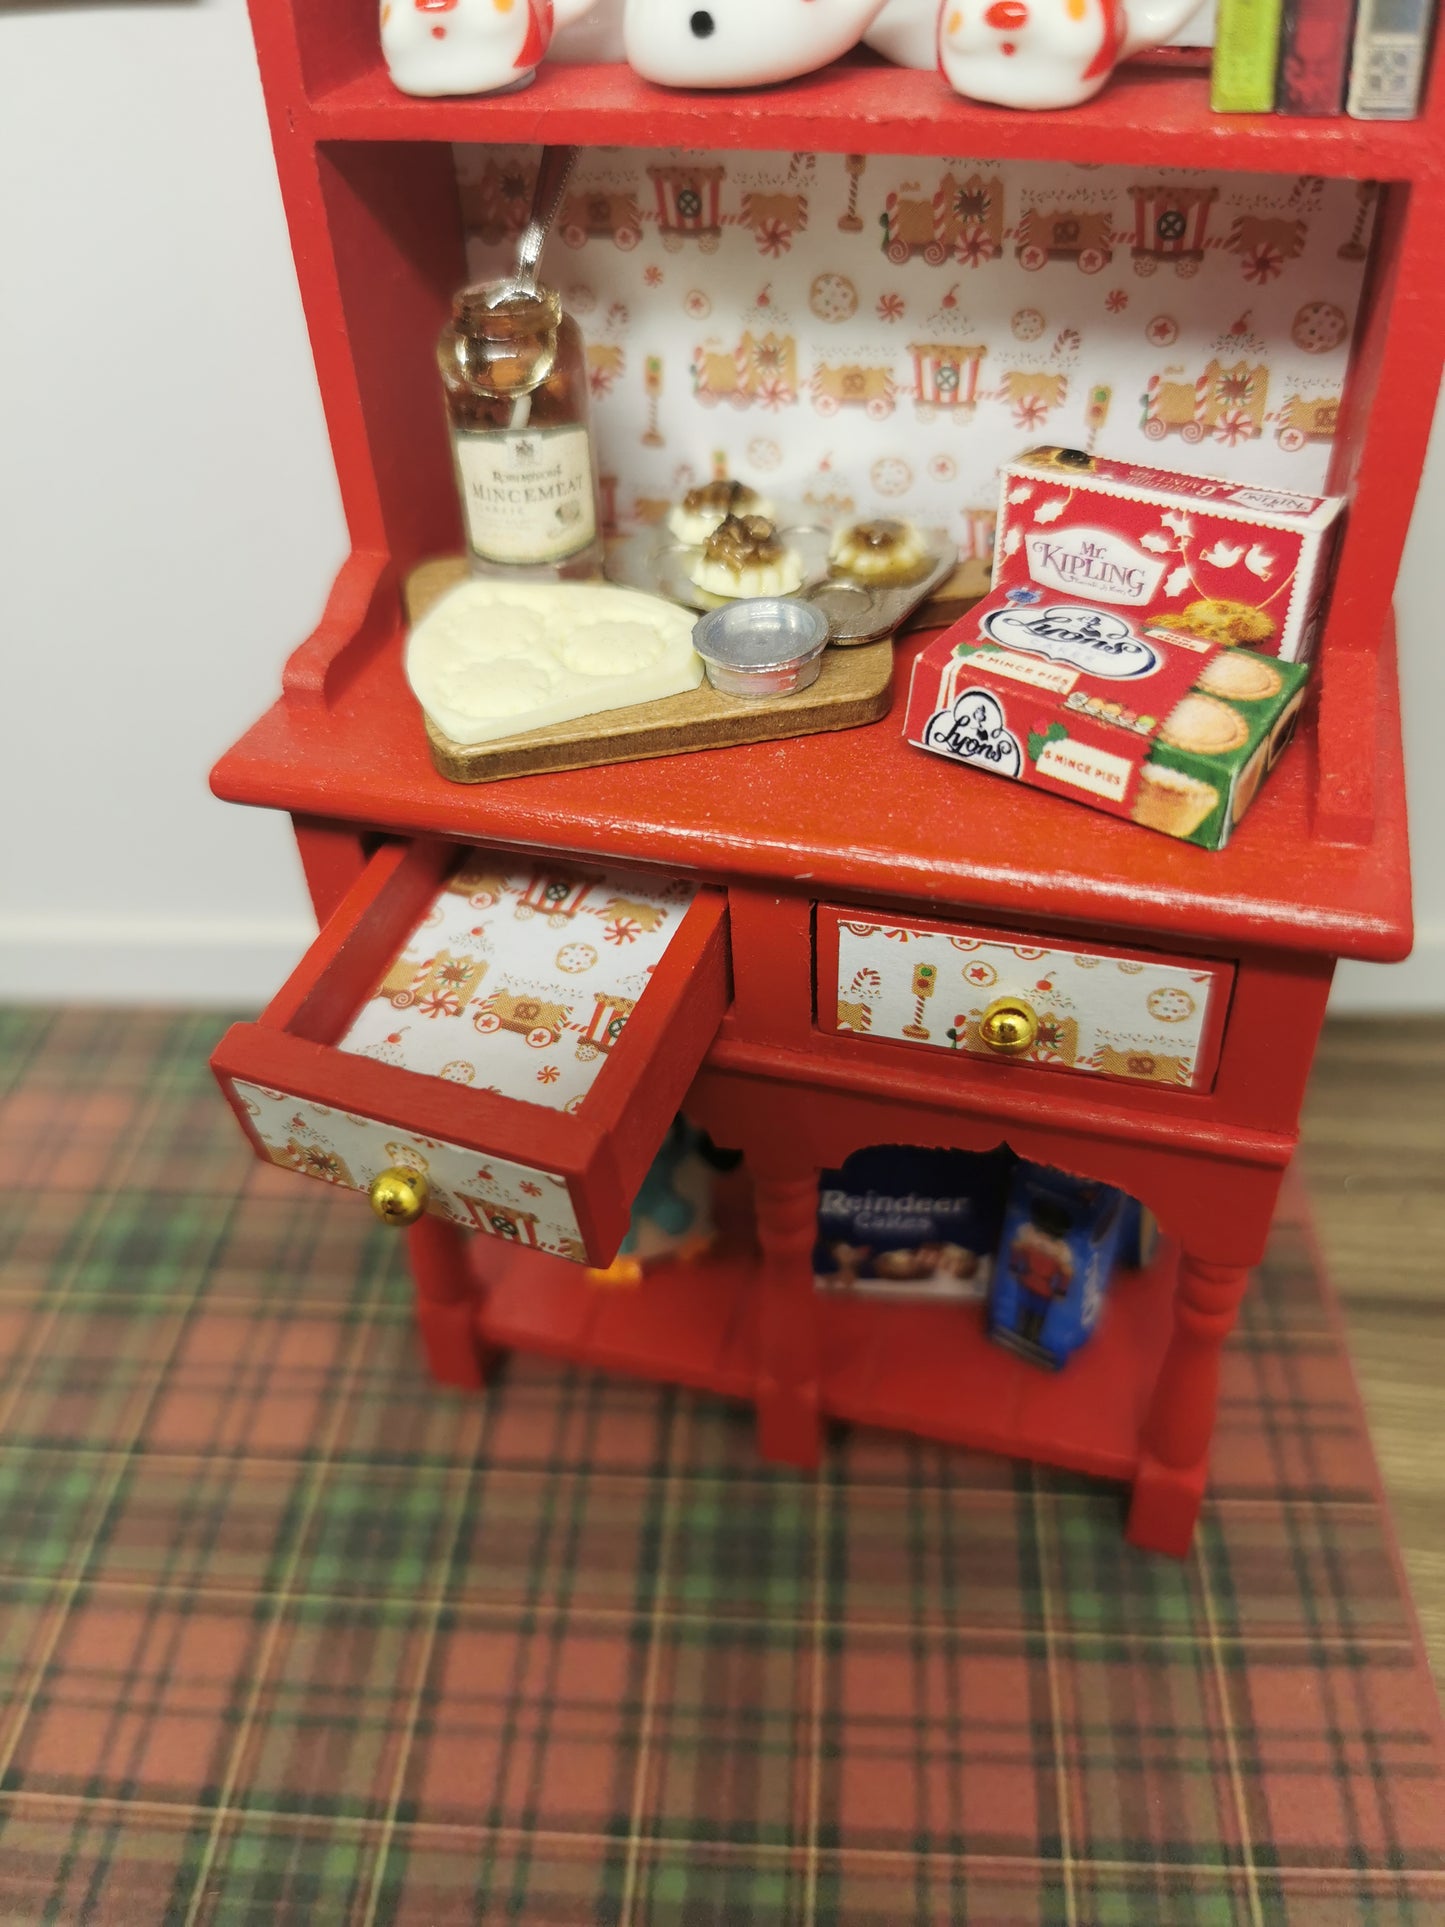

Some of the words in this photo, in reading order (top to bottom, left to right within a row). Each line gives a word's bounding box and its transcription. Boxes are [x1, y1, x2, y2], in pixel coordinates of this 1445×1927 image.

[471, 475, 583, 504] MINCEMEAT
[1080, 541, 1107, 559] Mr.
[1032, 541, 1146, 597] KIPLING
[1002, 616, 1143, 655] Lyons
[988, 656, 1034, 674] MINCE
[1037, 671, 1069, 685] PIES
[934, 714, 1012, 763] Lyons
[1054, 752, 1092, 775] MINCE
[1094, 769, 1121, 786] PIES
[819, 1189, 970, 1215] Reindeer
[854, 1212, 933, 1231] Cakes
